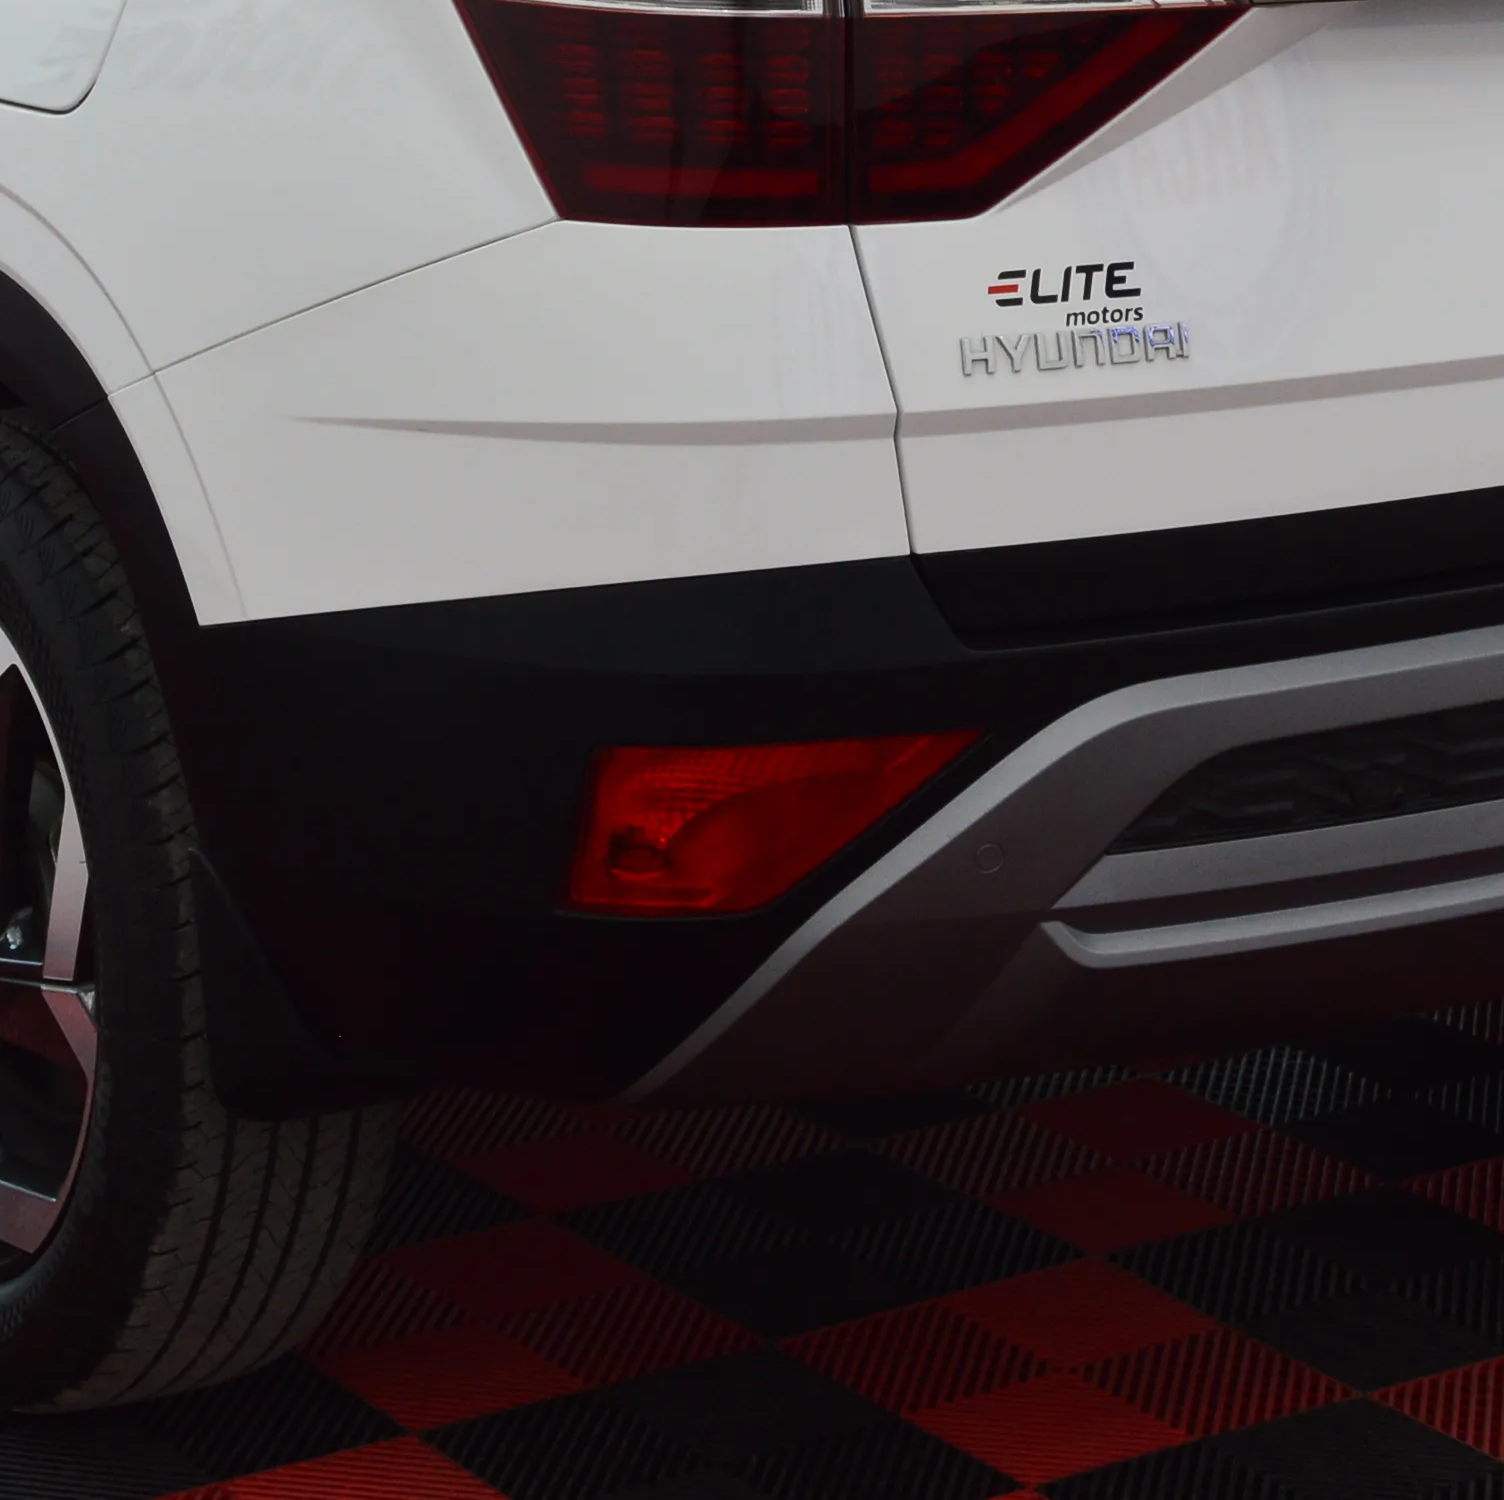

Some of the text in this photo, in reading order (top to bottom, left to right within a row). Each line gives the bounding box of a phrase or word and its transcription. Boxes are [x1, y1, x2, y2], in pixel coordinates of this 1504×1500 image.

[987, 261, 1142, 308] ELITE
[1065, 306, 1144, 327] motors
[959, 322, 1191, 377] HYUNDAI
